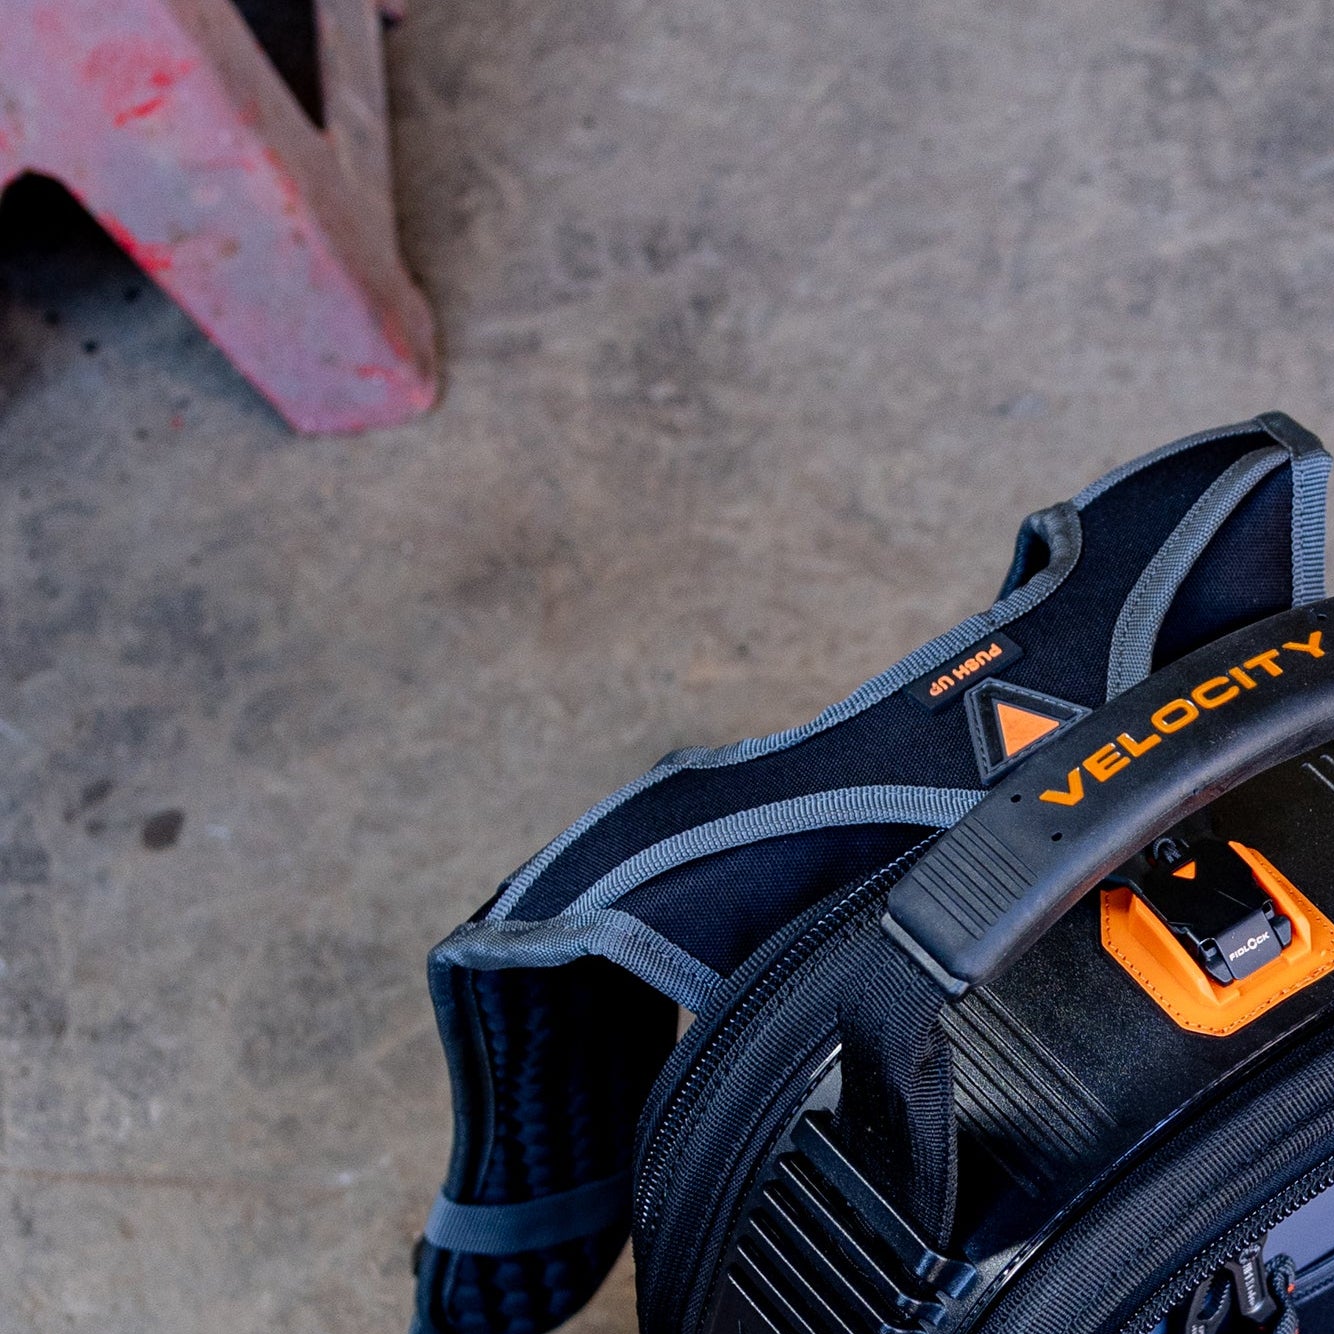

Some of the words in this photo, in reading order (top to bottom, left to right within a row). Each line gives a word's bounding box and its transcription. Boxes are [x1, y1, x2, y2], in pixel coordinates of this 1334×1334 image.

[952, 641, 1004, 681] PUSH
[929, 670, 953, 697] UP
[1038, 629, 1327, 808] VELOCITY
[1228, 931, 1271, 962] FIDLOCK
